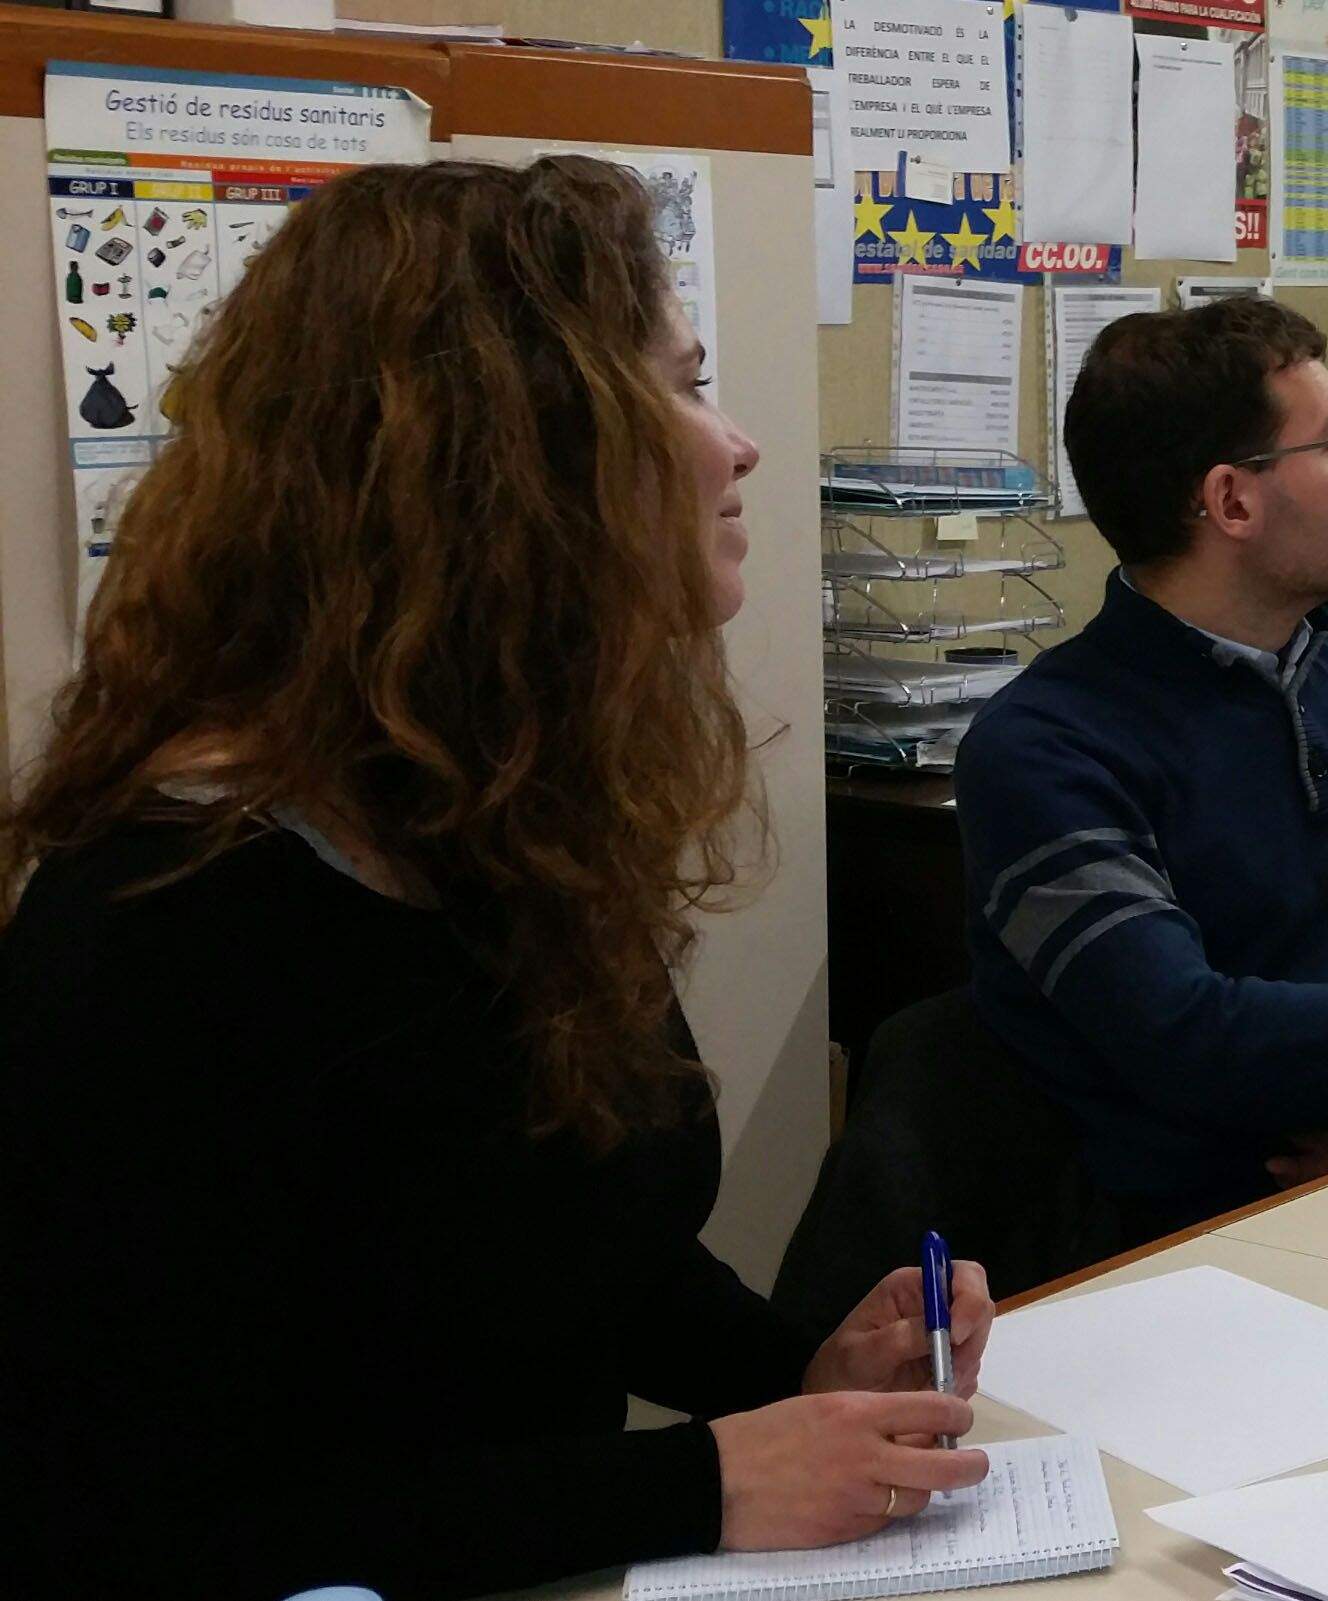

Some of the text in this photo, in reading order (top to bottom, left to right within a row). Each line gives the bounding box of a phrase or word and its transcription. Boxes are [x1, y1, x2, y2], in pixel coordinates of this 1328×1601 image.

[1198, 6, 1208, 17] LA
[844, 20, 855, 29] LA
[979, 30, 988, 39] LA
[908, 51, 935, 62] ENTRE
[942, 53, 950, 63] EL
[956, 54, 973, 65] QUE
[981, 55, 990, 66] EL
[932, 79, 960, 89] ESPERA
[979, 81, 990, 91] DE
[106, 90, 385, 128] Gestió de residus sanitaris
[849, 100, 897, 112] 'EMPRESA
[911, 103, 920, 113] EL
[948, 105, 991, 116] L'EMPRESA
[126, 122, 152, 142] Els
[160, 125, 225, 146] residus
[231, 128, 260, 147] són
[307, 132, 326, 151] de
[332, 135, 367, 152] tots
[851, 127, 895, 139] REALMENT
[907, 129, 967, 141] PROPORCIONA
[69, 180, 119, 195] GRUP I
[225, 187, 281, 201] GRUP III
[925, 241, 943, 259] de
[1026, 242, 1102, 269] CC.OO.
